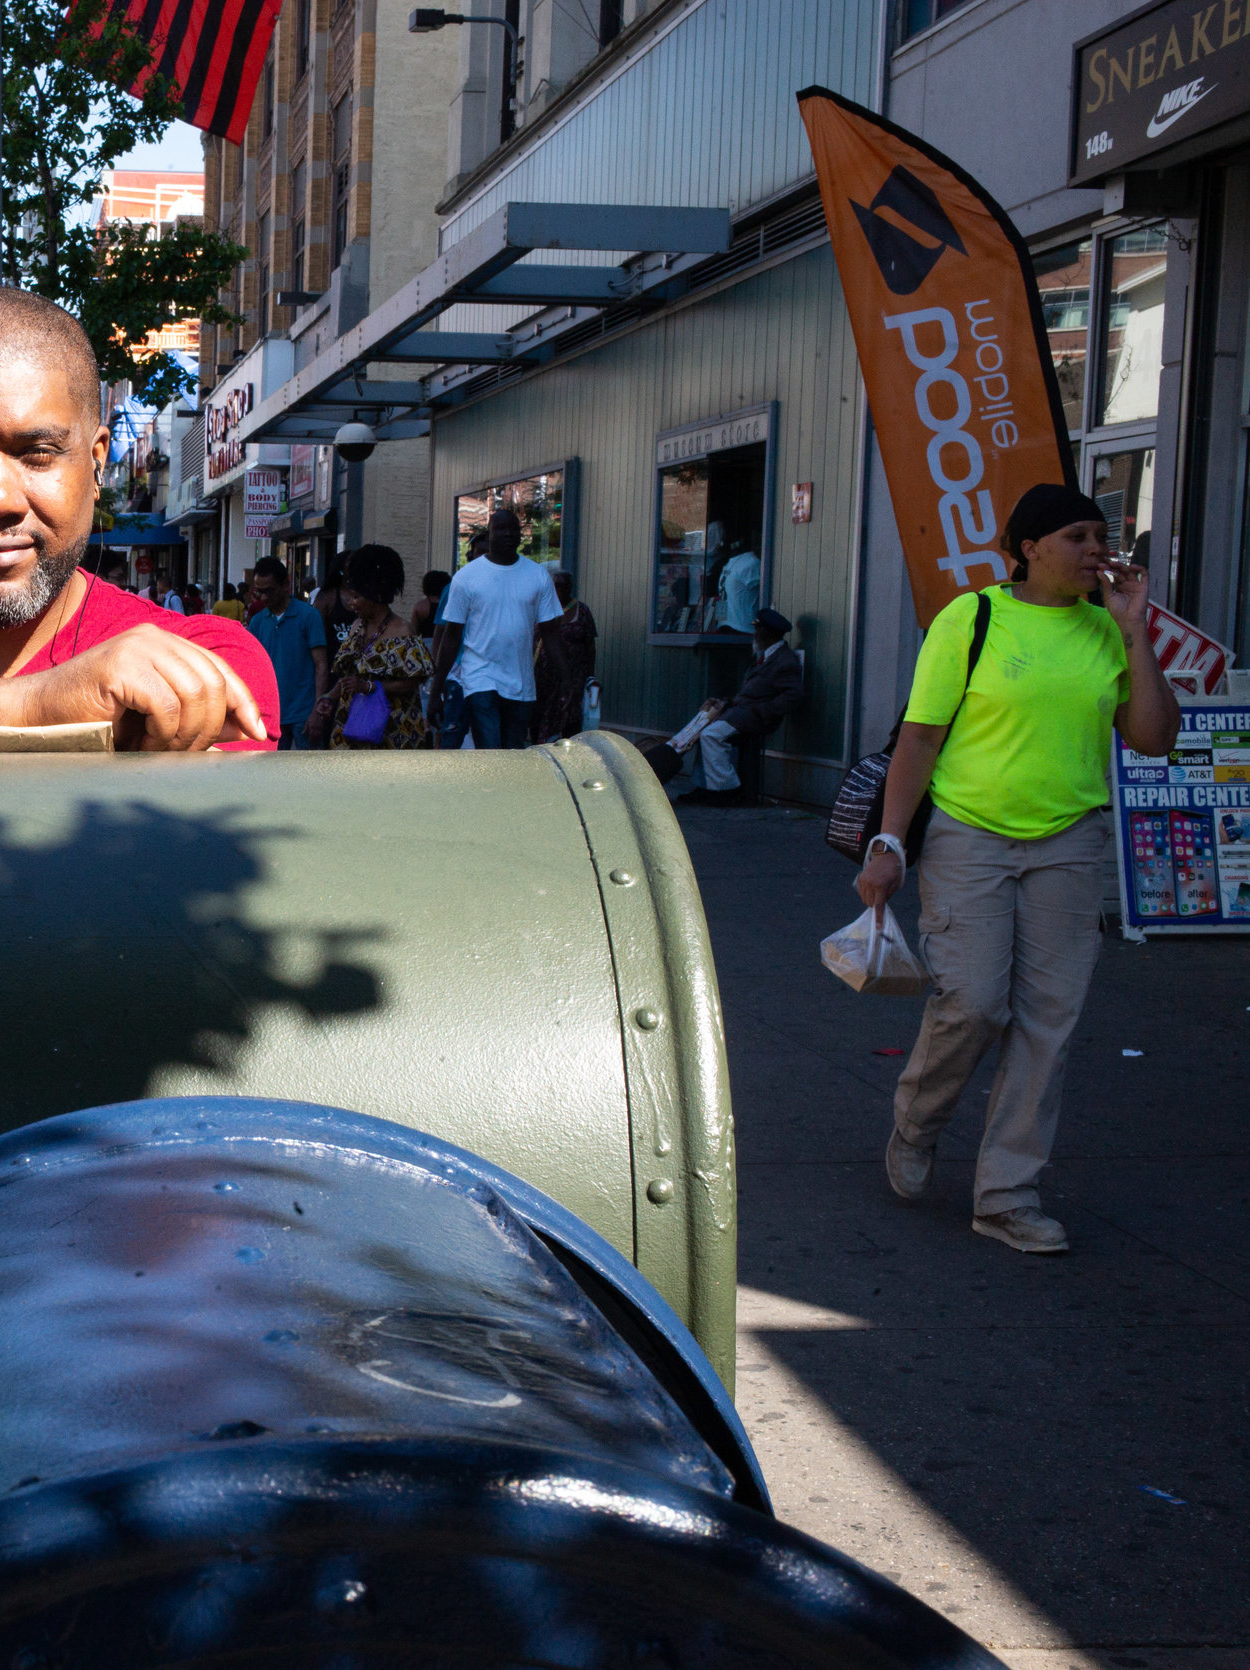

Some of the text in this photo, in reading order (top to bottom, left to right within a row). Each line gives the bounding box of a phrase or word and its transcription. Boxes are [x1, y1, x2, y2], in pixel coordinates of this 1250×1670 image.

[1086, 0, 1250, 113] SNEAKE
[1157, 76, 1205, 117] NIKE
[663, 420, 761, 462] museum store
[248, 472, 278, 487] TATTOO
[248, 494, 277, 502] BODY
[1147, 607, 1222, 684] TM
[1178, 755, 1210, 764] smart
[1188, 770, 1212, 779] AT&T
[1124, 787, 1189, 807] REPAIR
[1141, 889, 1170, 899] before
[1187, 889, 1208, 899] after
